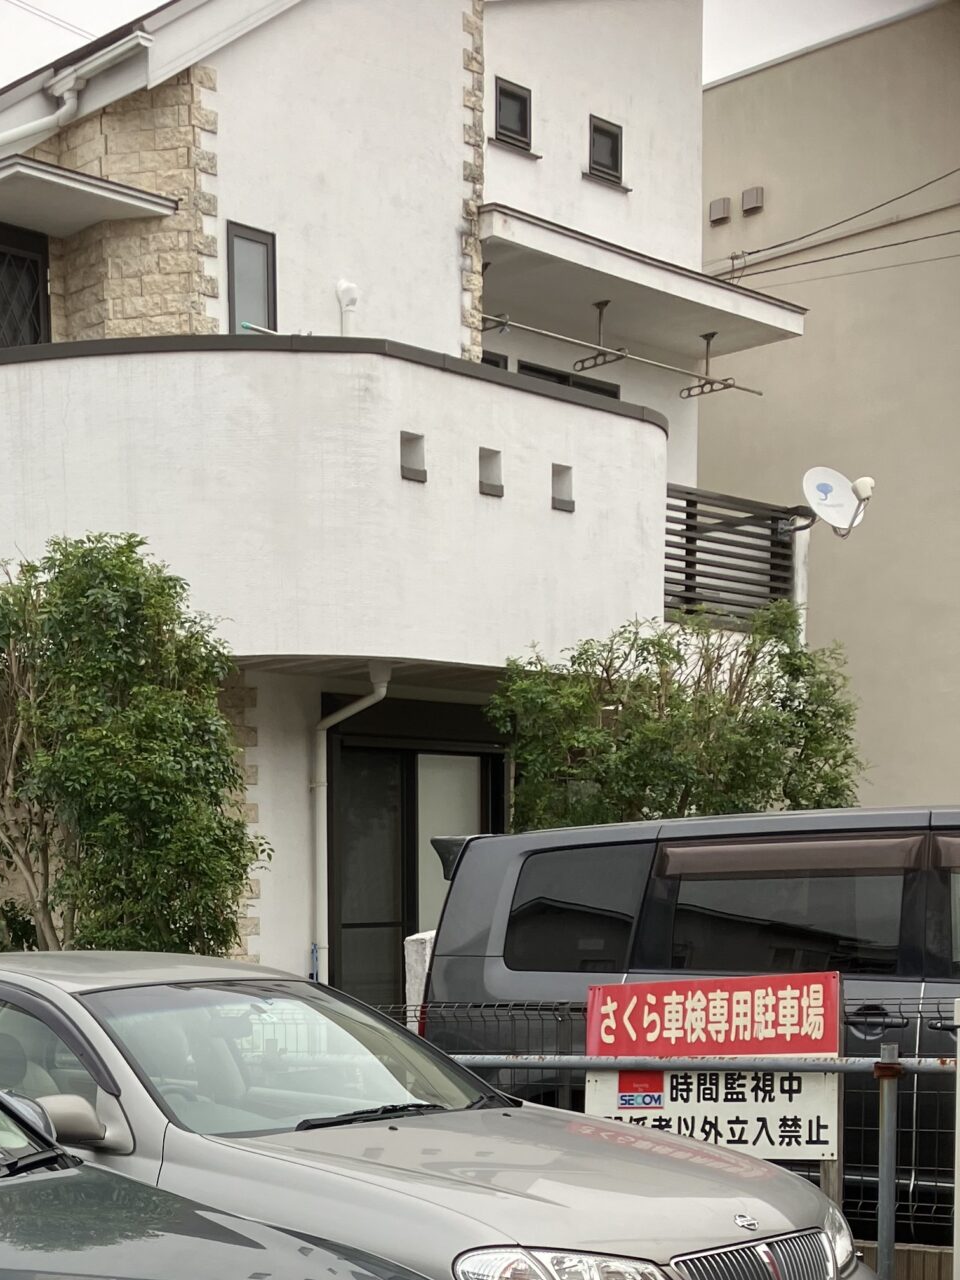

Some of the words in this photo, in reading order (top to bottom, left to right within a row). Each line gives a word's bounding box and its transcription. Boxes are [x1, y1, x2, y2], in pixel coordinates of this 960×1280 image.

[600, 984, 825, 1045] さくら車検専用駐車場
[620, 1094, 662, 1106] SECOM
[670, 1072, 802, 1103] 時間監視中
[604, 1115, 829, 1147] 者以外立入禁止
